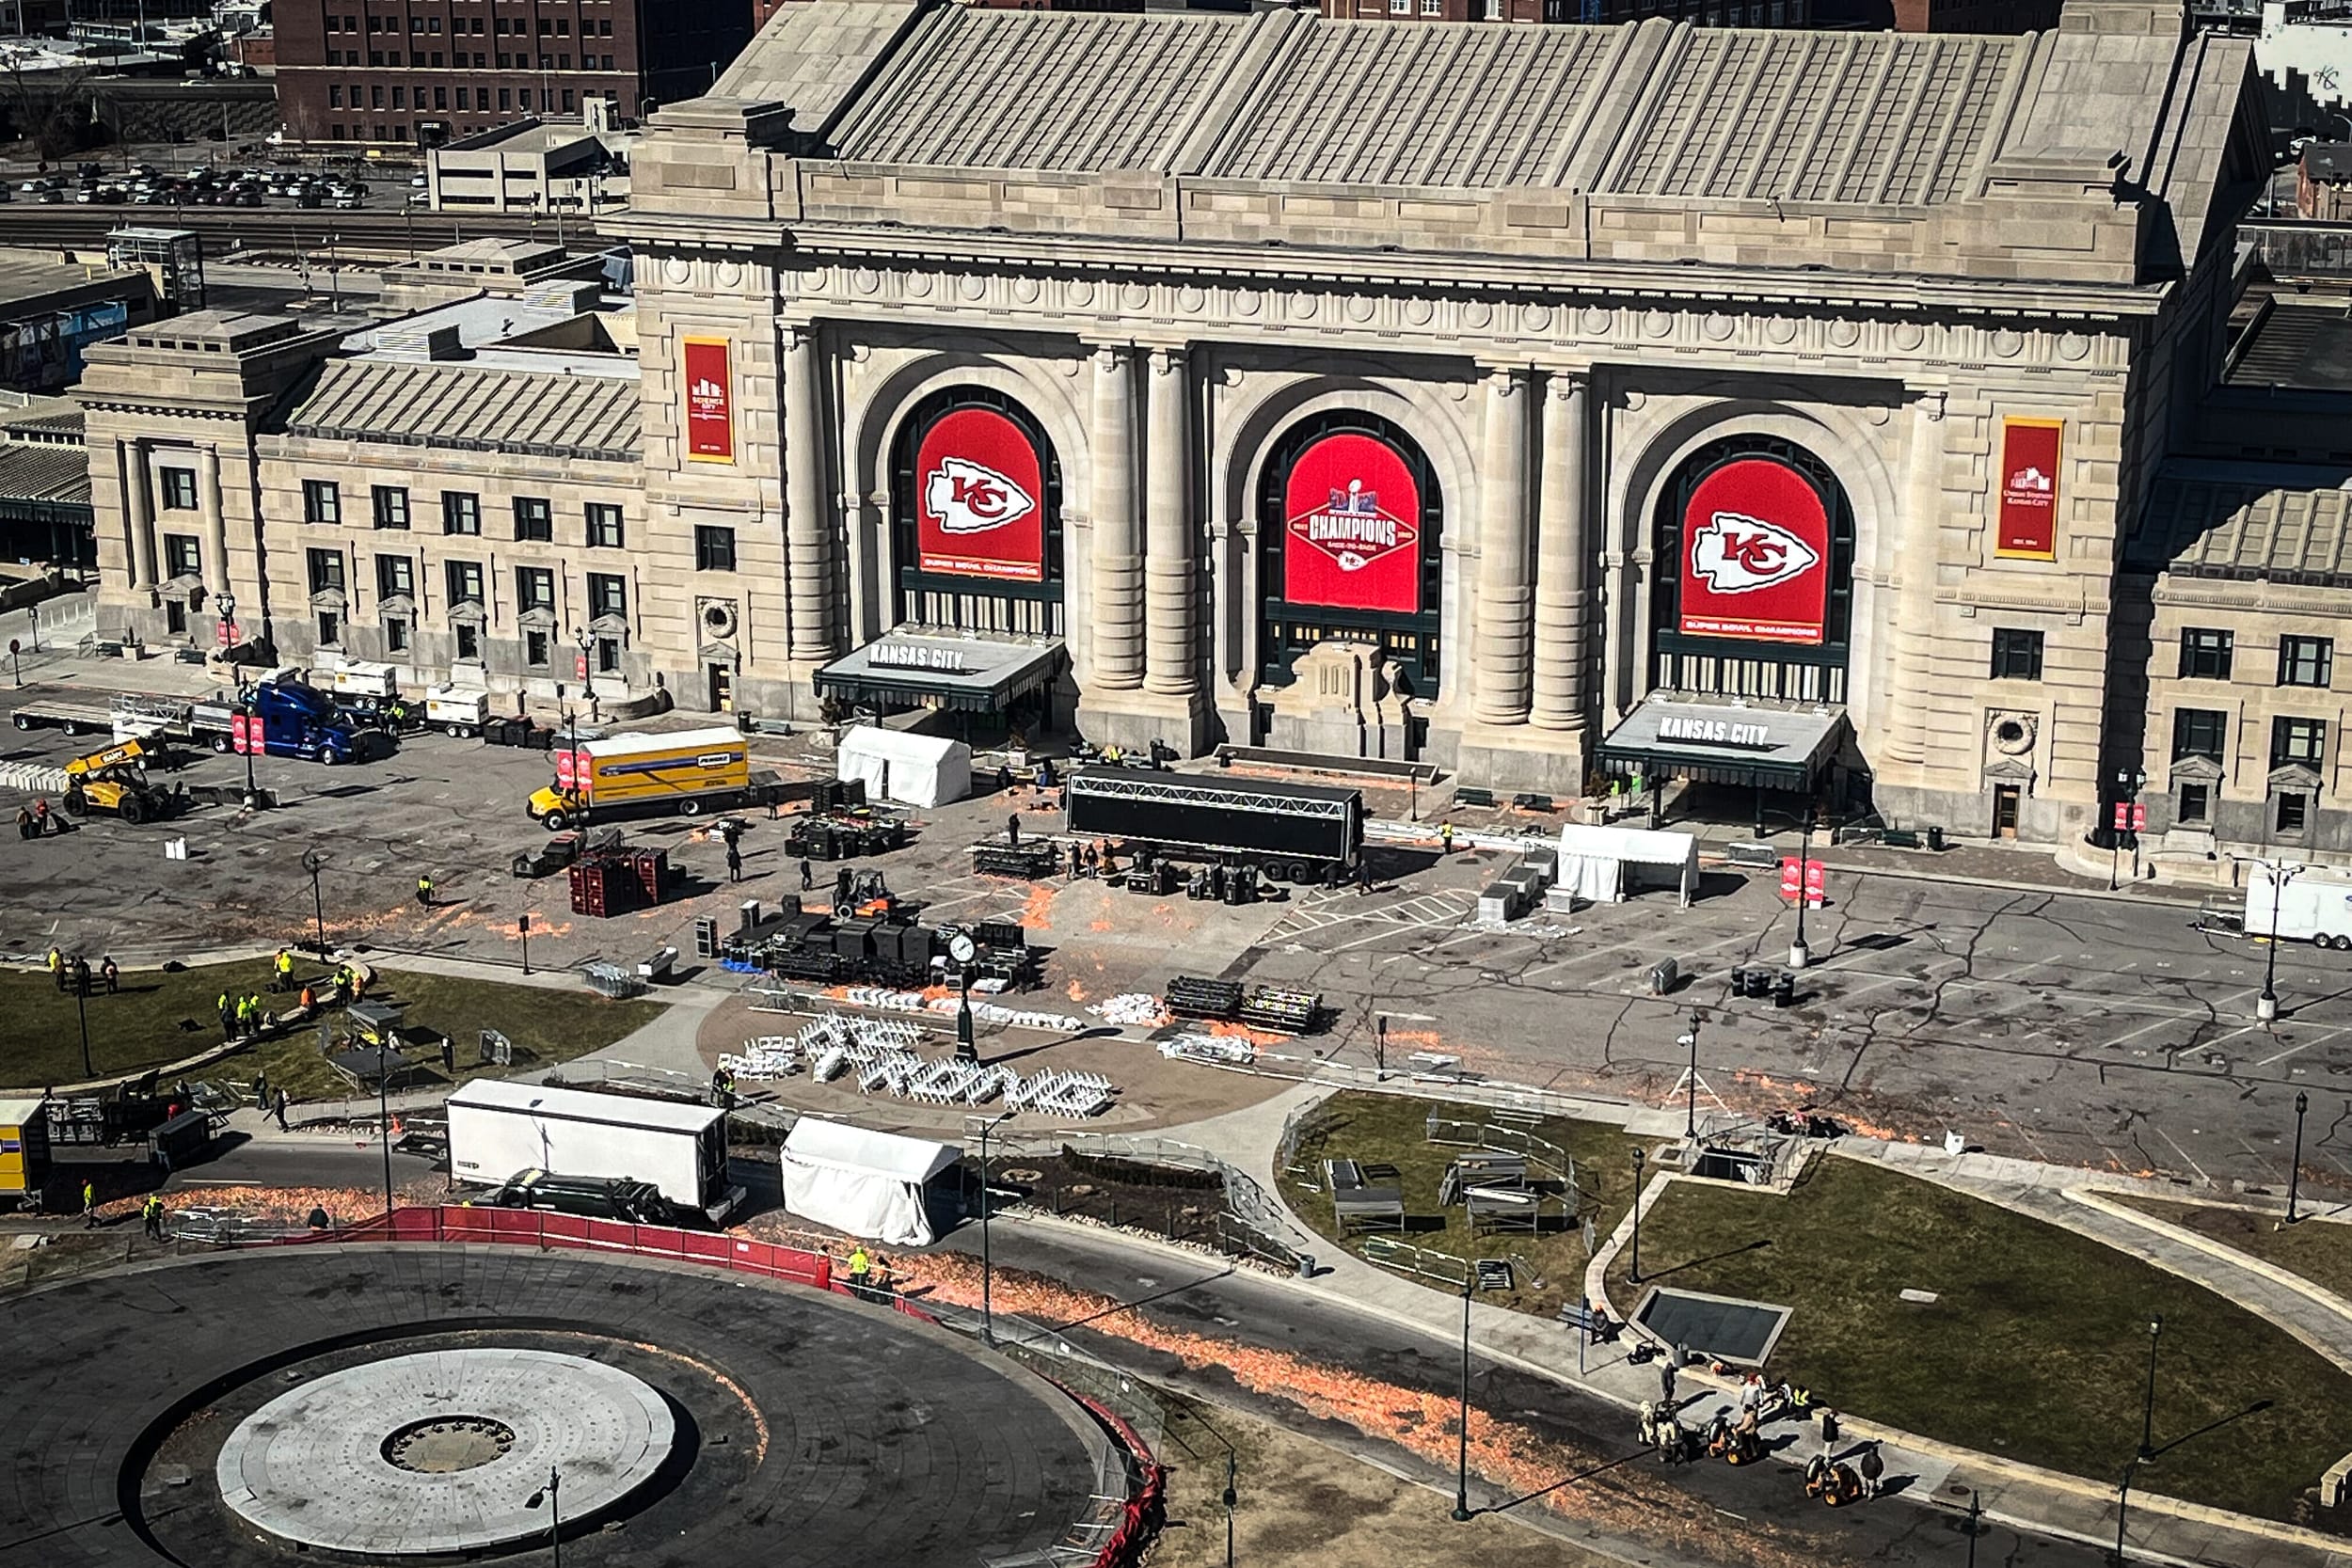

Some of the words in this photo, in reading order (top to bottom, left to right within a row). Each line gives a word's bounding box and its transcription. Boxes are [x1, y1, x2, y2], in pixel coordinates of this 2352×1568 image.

[951, 476, 1008, 517] KC
[1309, 515, 1396, 547] CHAMPIONS
[924, 558, 954, 568] SUPER
[954, 562, 982, 571] BOWL
[983, 563, 1039, 576] CHAMPIONS
[1722, 532, 1787, 575] KC
[1685, 621, 1720, 631] SUPER
[1721, 623, 1753, 633] BOWL
[1754, 625, 1819, 637] CHAMPIONS
[869, 643, 927, 667] KANSAS
[931, 648, 963, 670] CITY
[1659, 717, 1726, 741] KANSAS
[1729, 723, 1769, 746] CITY
